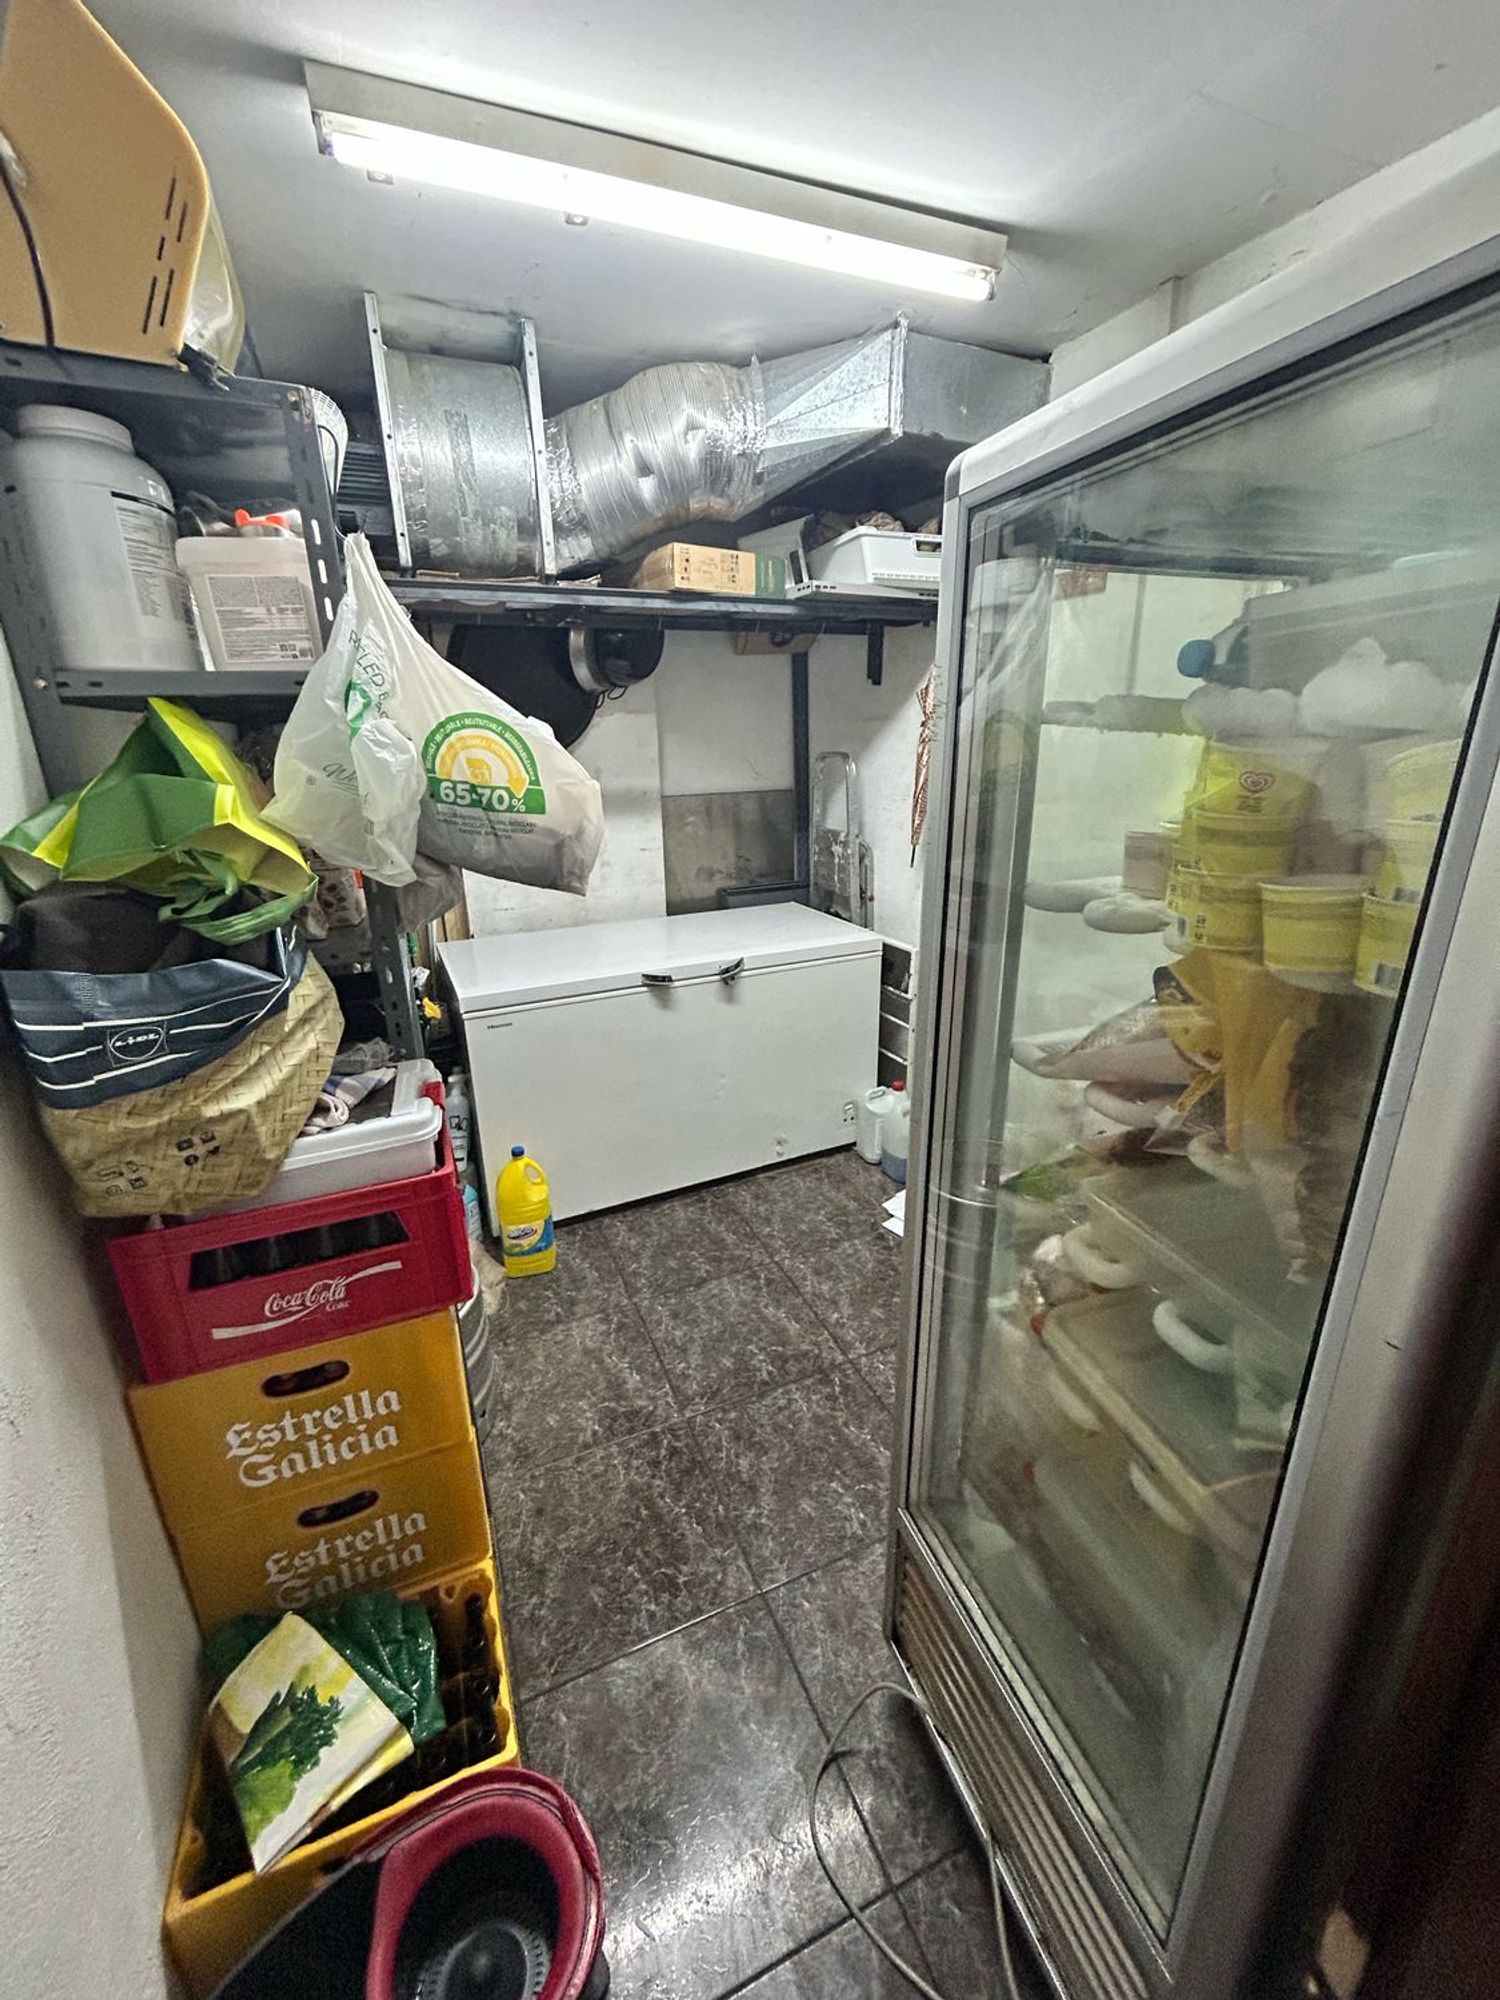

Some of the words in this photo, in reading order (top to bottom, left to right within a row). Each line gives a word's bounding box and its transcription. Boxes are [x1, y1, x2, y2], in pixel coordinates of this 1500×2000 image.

[225, 1389, 402, 1459] Estrella
[239, 1424, 400, 1488] Galicia
[265, 1512, 428, 1585] Estrella
[276, 1543, 426, 1610] Galicia
